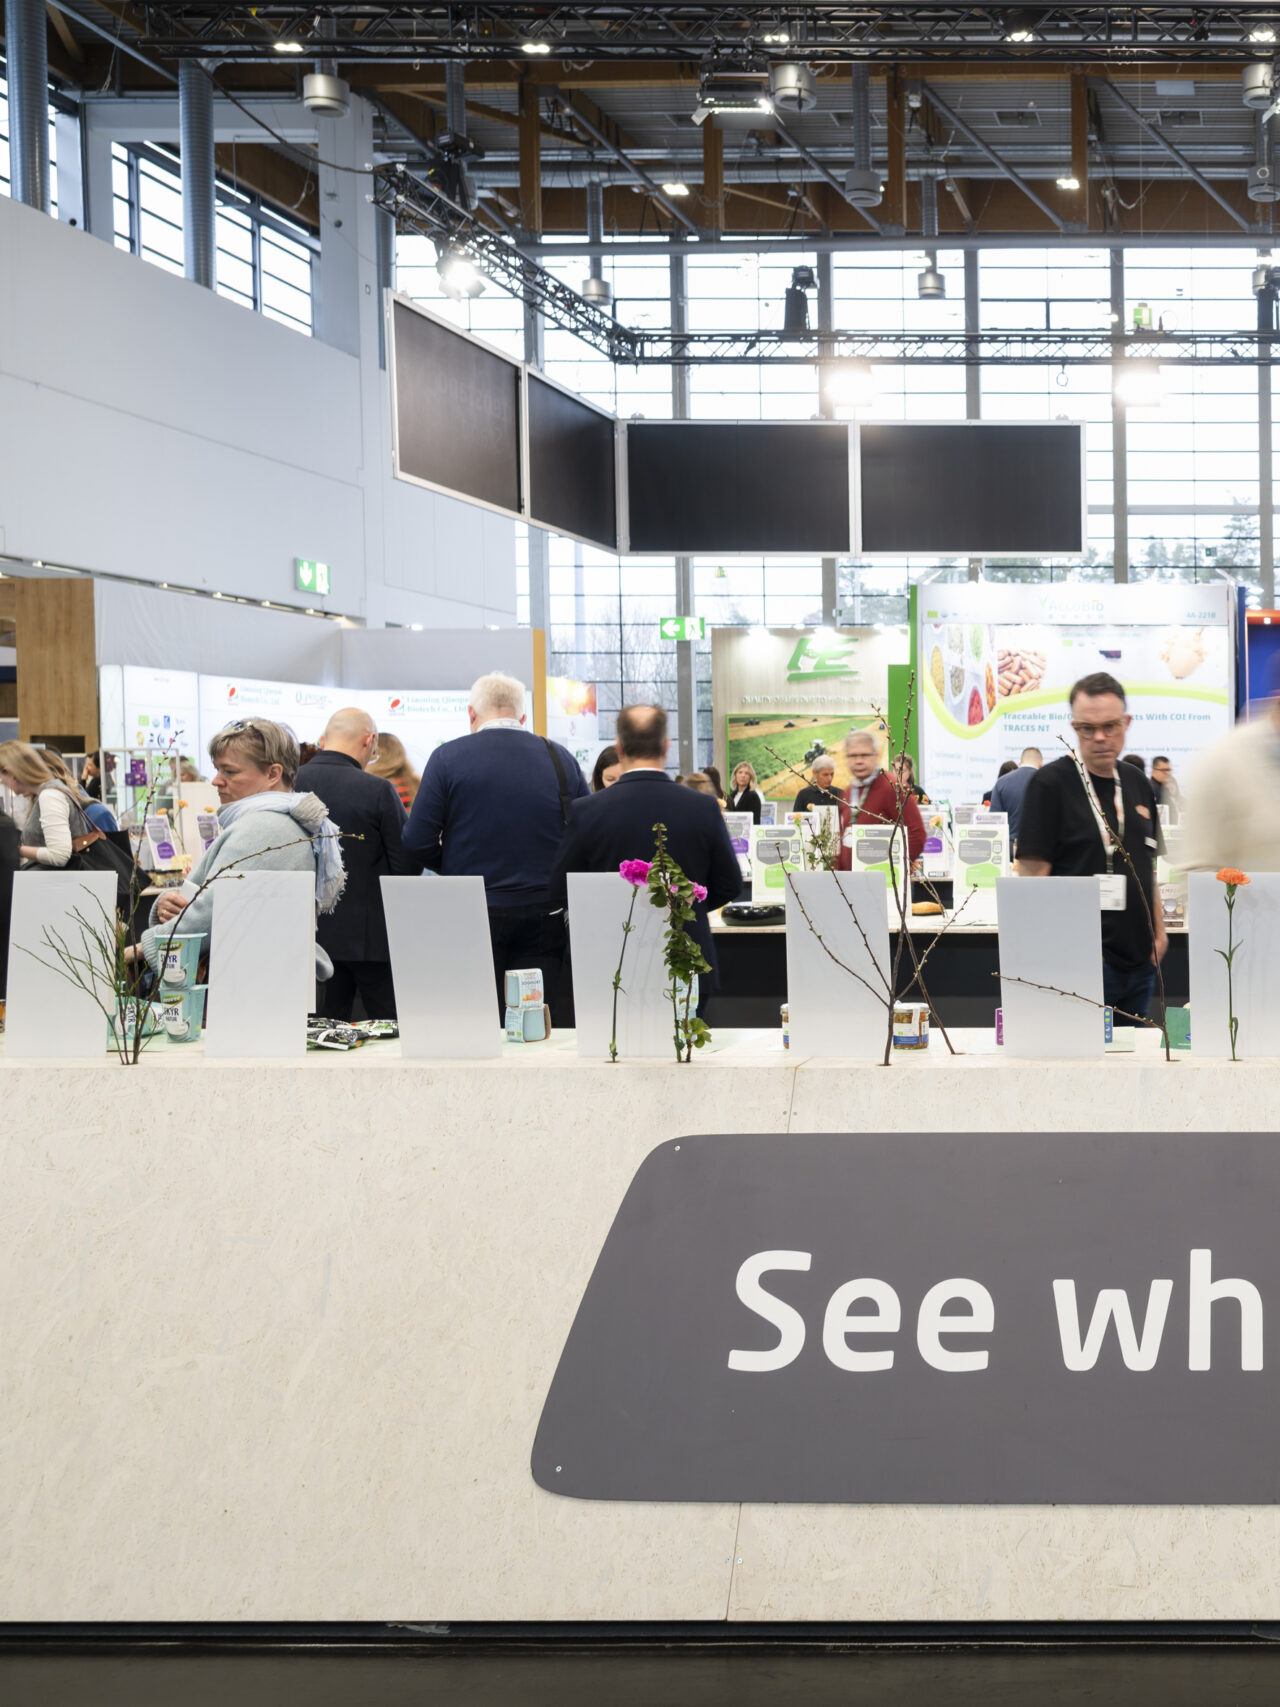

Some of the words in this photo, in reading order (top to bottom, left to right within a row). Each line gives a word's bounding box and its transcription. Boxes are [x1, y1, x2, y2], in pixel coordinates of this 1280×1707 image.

[1004, 712, 1046, 720] Traceable
[1146, 713, 1168, 721] With
[1170, 713, 1186, 721] COI
[1188, 713, 1211, 721] From
[160, 954, 177, 963] SYR
[727, 1248, 996, 1373] See
